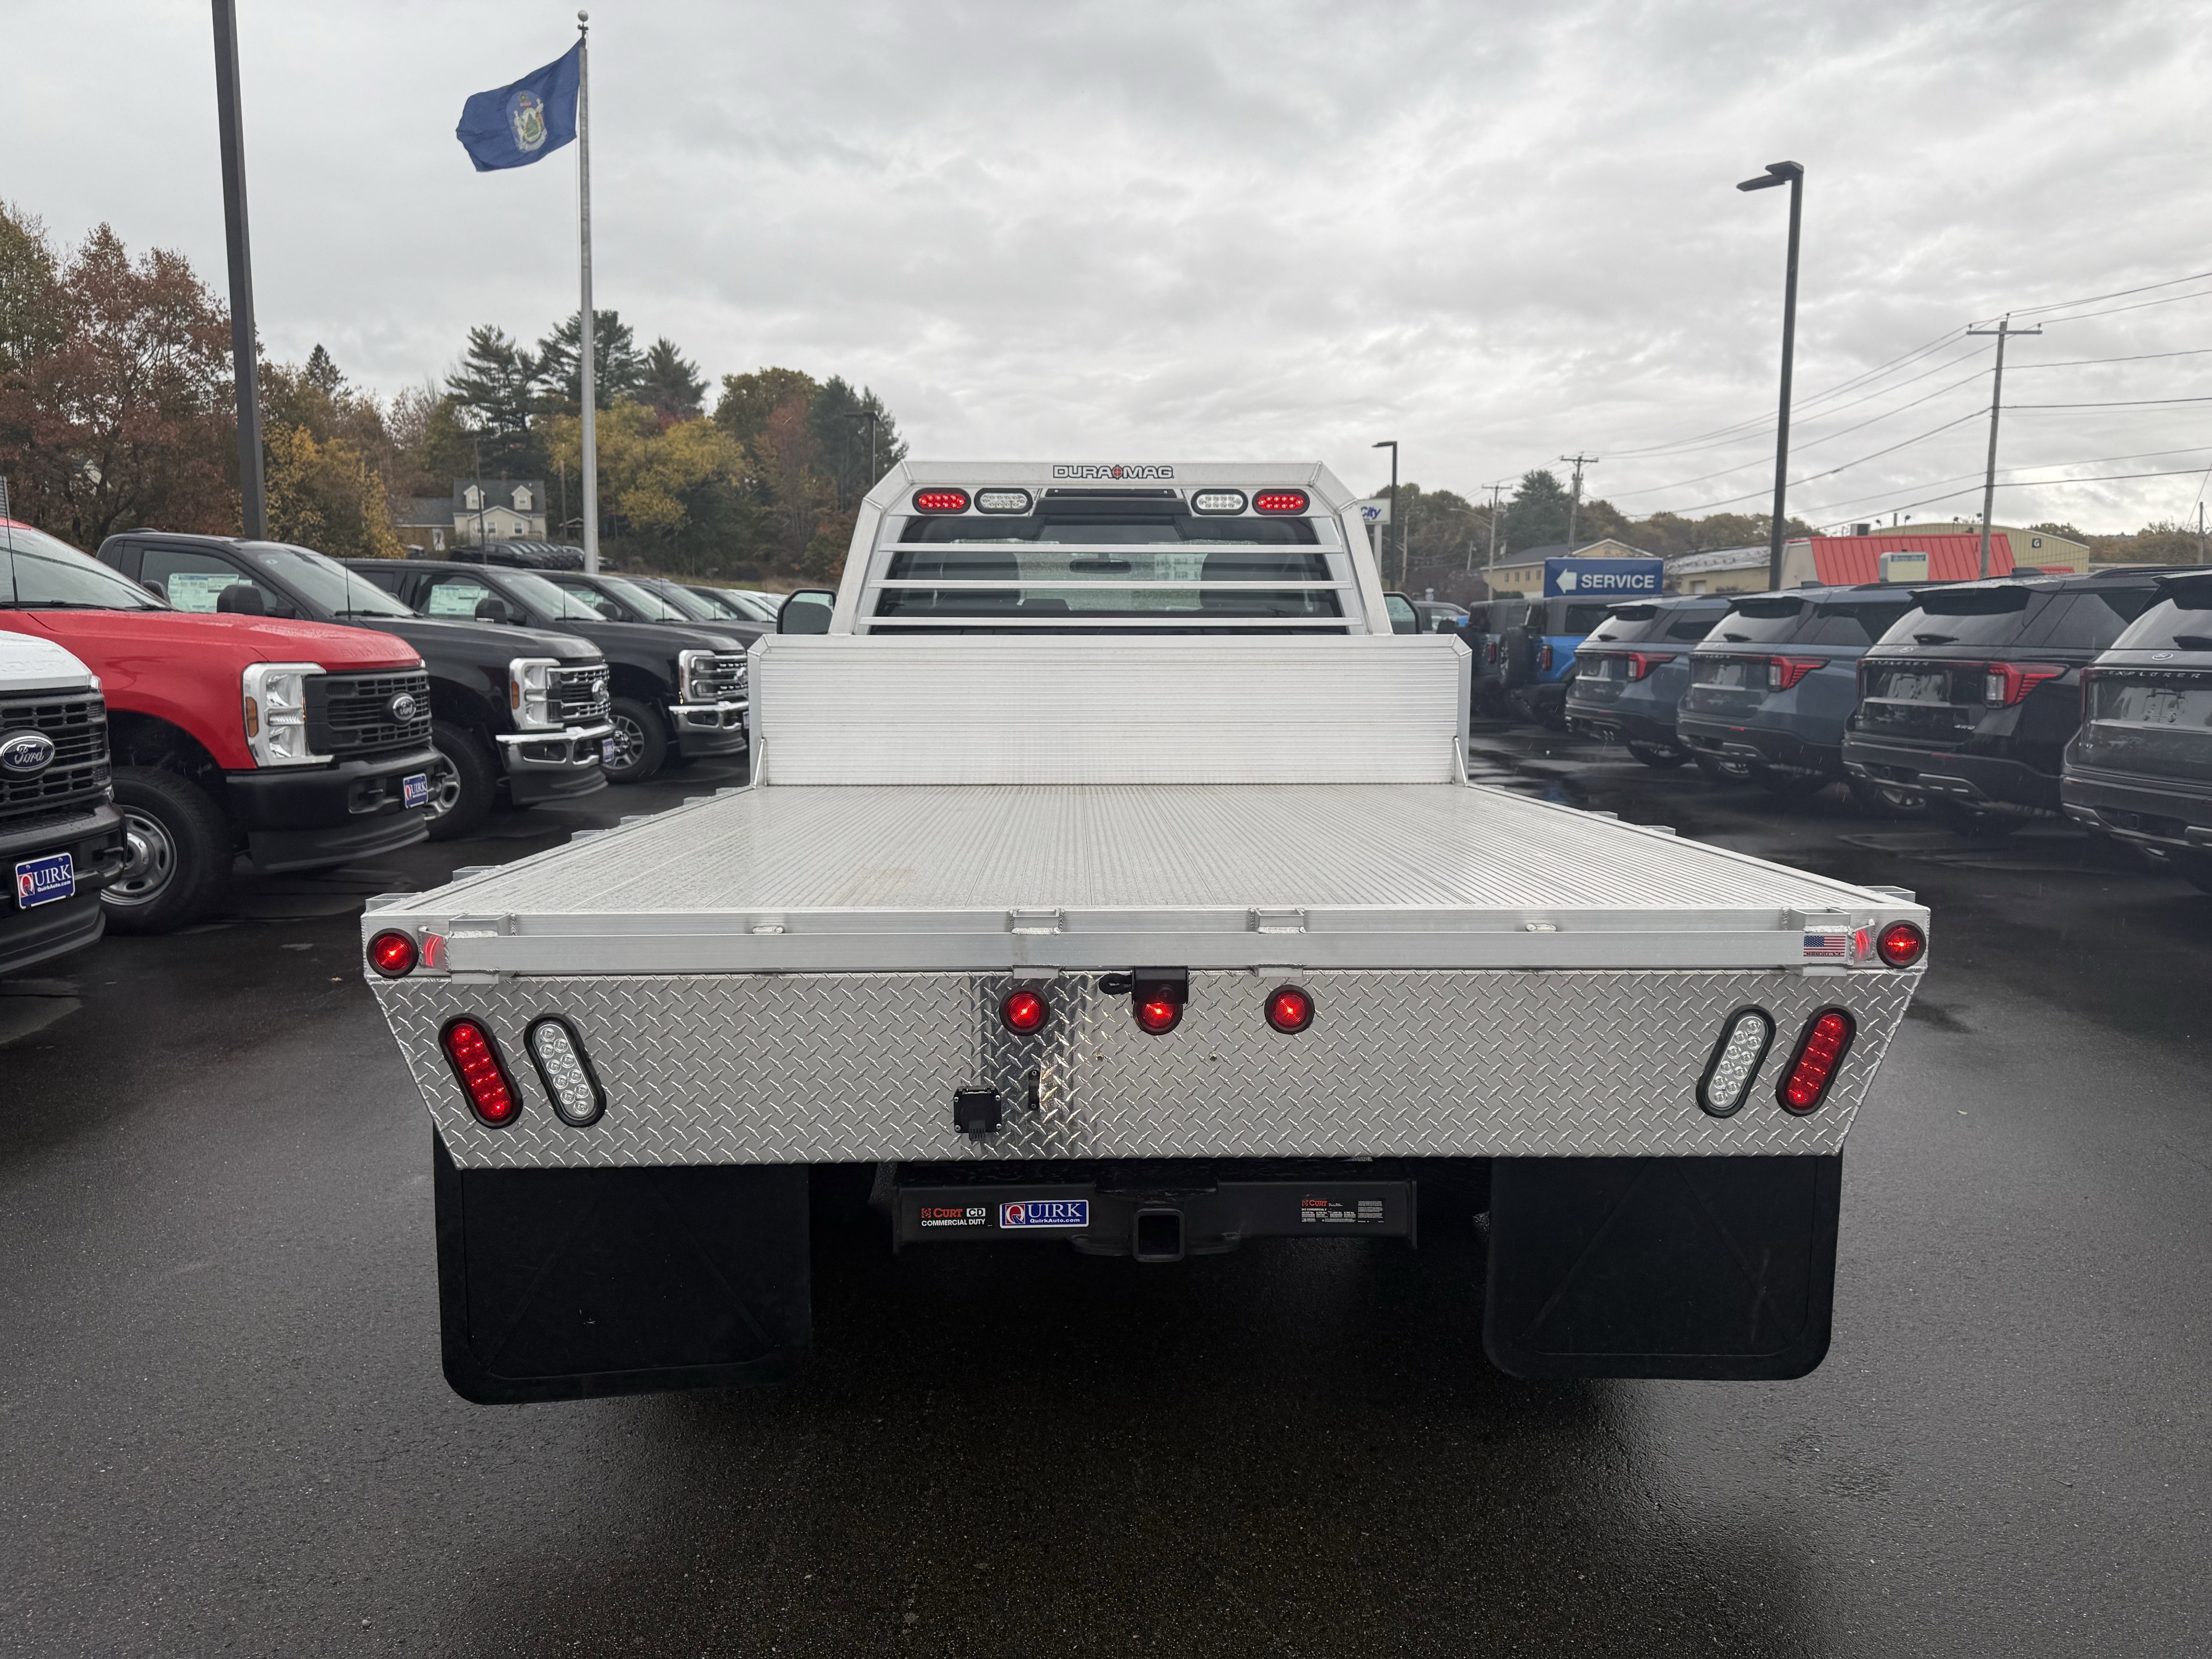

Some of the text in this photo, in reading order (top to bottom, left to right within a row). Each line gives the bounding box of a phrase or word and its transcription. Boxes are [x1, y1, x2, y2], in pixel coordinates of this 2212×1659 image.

[1581, 574, 1655, 588] SERVICE
[14, 744, 45, 765] Ford
[405, 781, 426, 801] QUIRK
[20, 864, 72, 896] QUIRK
[37, 880, 71, 892] QuirkAuto.com
[933, 1208, 963, 1218] CURT
[1006, 1203, 1084, 1224] QUIRK
